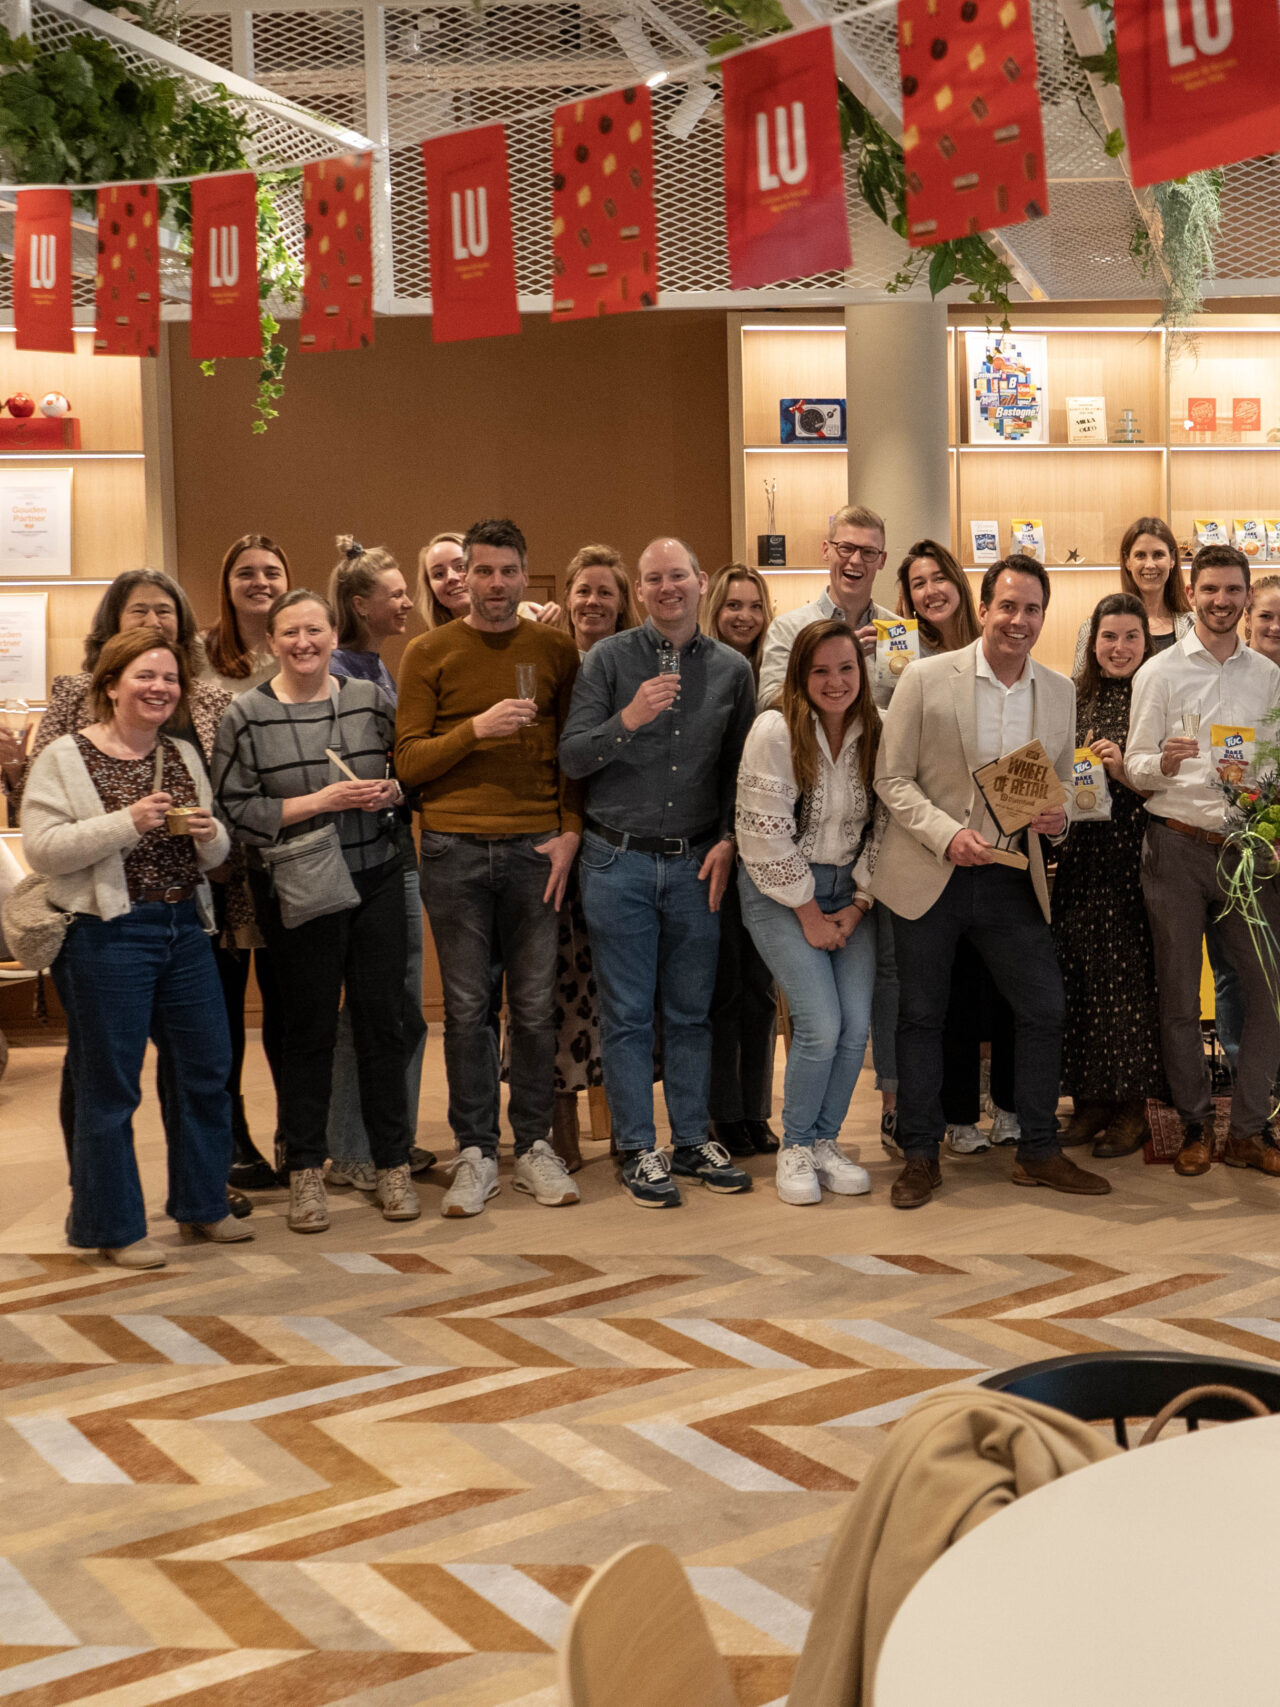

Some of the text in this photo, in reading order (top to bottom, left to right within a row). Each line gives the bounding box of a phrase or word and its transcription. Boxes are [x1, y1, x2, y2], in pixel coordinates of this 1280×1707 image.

[756, 101, 808, 191] LU
[451, 186, 489, 260] LU
[30, 234, 56, 289] LU
[209, 225, 239, 288] LU
[996, 405, 1041, 419] Bastogne!
[889, 626, 905, 637] TUC
[1225, 736, 1242, 747] TUC
[1008, 757, 1048, 783] WHEEL
[1075, 761, 1091, 773] TUC
[993, 775, 1049, 799] OF RETAIL
